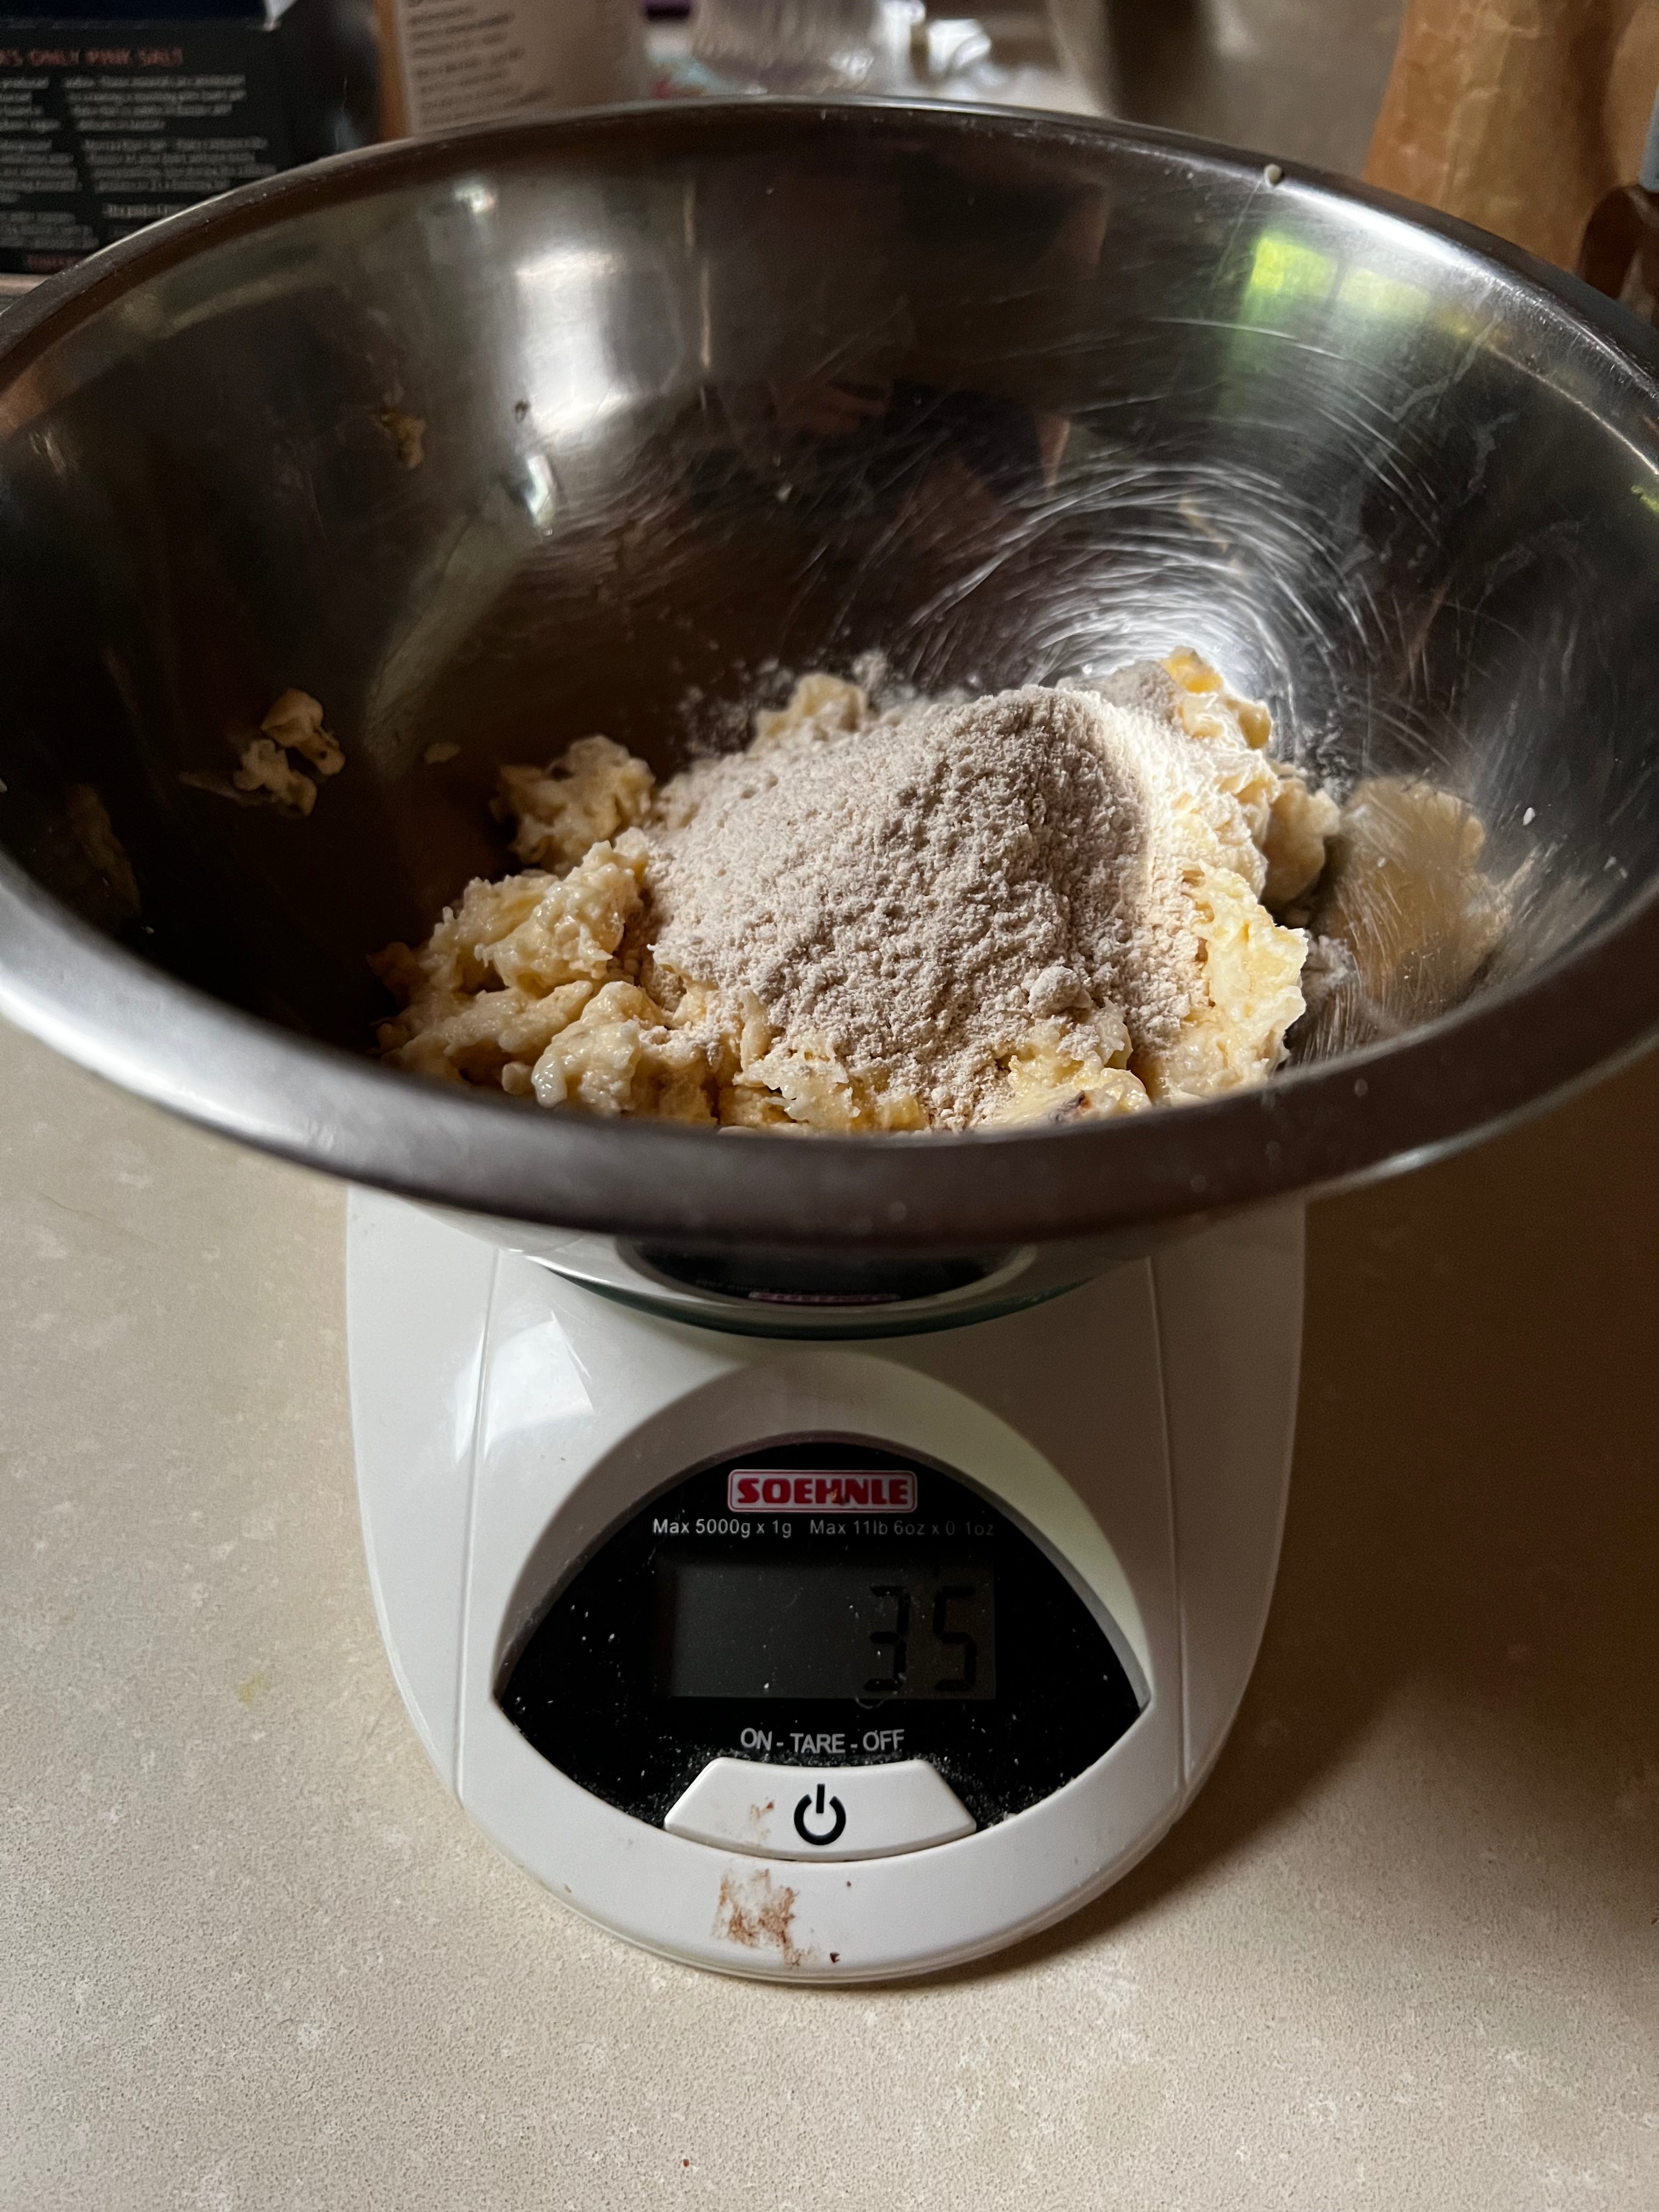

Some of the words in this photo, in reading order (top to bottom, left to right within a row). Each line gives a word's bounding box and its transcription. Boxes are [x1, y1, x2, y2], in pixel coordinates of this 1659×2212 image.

[737, 1477, 908, 1505] SOEHNLE
[652, 1519, 690, 1535] Max
[696, 1519, 751, 1537] 5000g
[756, 1524, 765, 1534] x
[772, 1520, 792, 1538] 1g
[810, 1520, 846, 1535] Max
[854, 1520, 888, 1535] 11lb
[894, 1520, 925, 1536] 6oz
[931, 1525, 940, 1536] x
[864, 1585, 979, 1692] 35
[740, 1728, 772, 1751] ON
[789, 1733, 845, 1754] TARE
[862, 1729, 905, 1752] OFF
